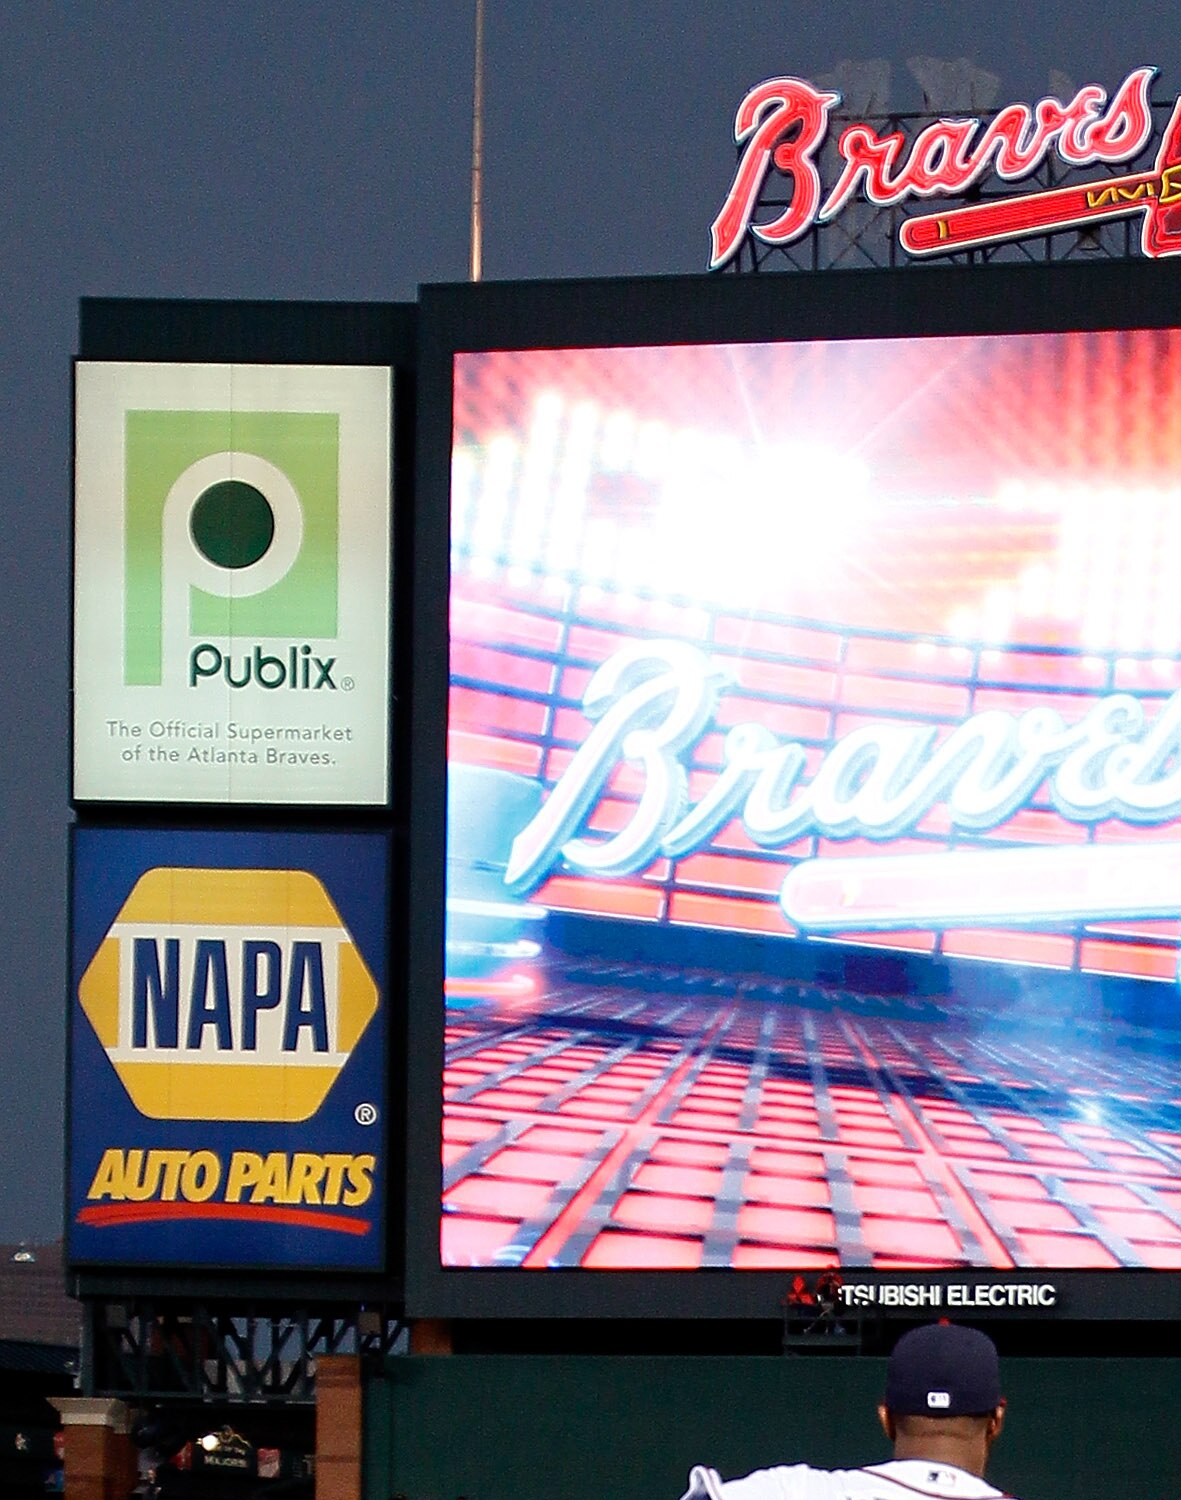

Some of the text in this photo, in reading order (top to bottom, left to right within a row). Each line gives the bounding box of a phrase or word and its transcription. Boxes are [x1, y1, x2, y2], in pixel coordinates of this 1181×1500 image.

[708, 66, 1159, 272] Braves
[189, 643, 338, 690] Publix
[107, 721, 353, 744] The Official Supermarket
[122, 745, 337, 765] of the Atlanta Braves.
[132, 937, 329, 1053] NAPA
[87, 1148, 376, 1206] AUTO PARTS
[838, 1284, 1056, 1307] TSUBISHI ELECTRIC
